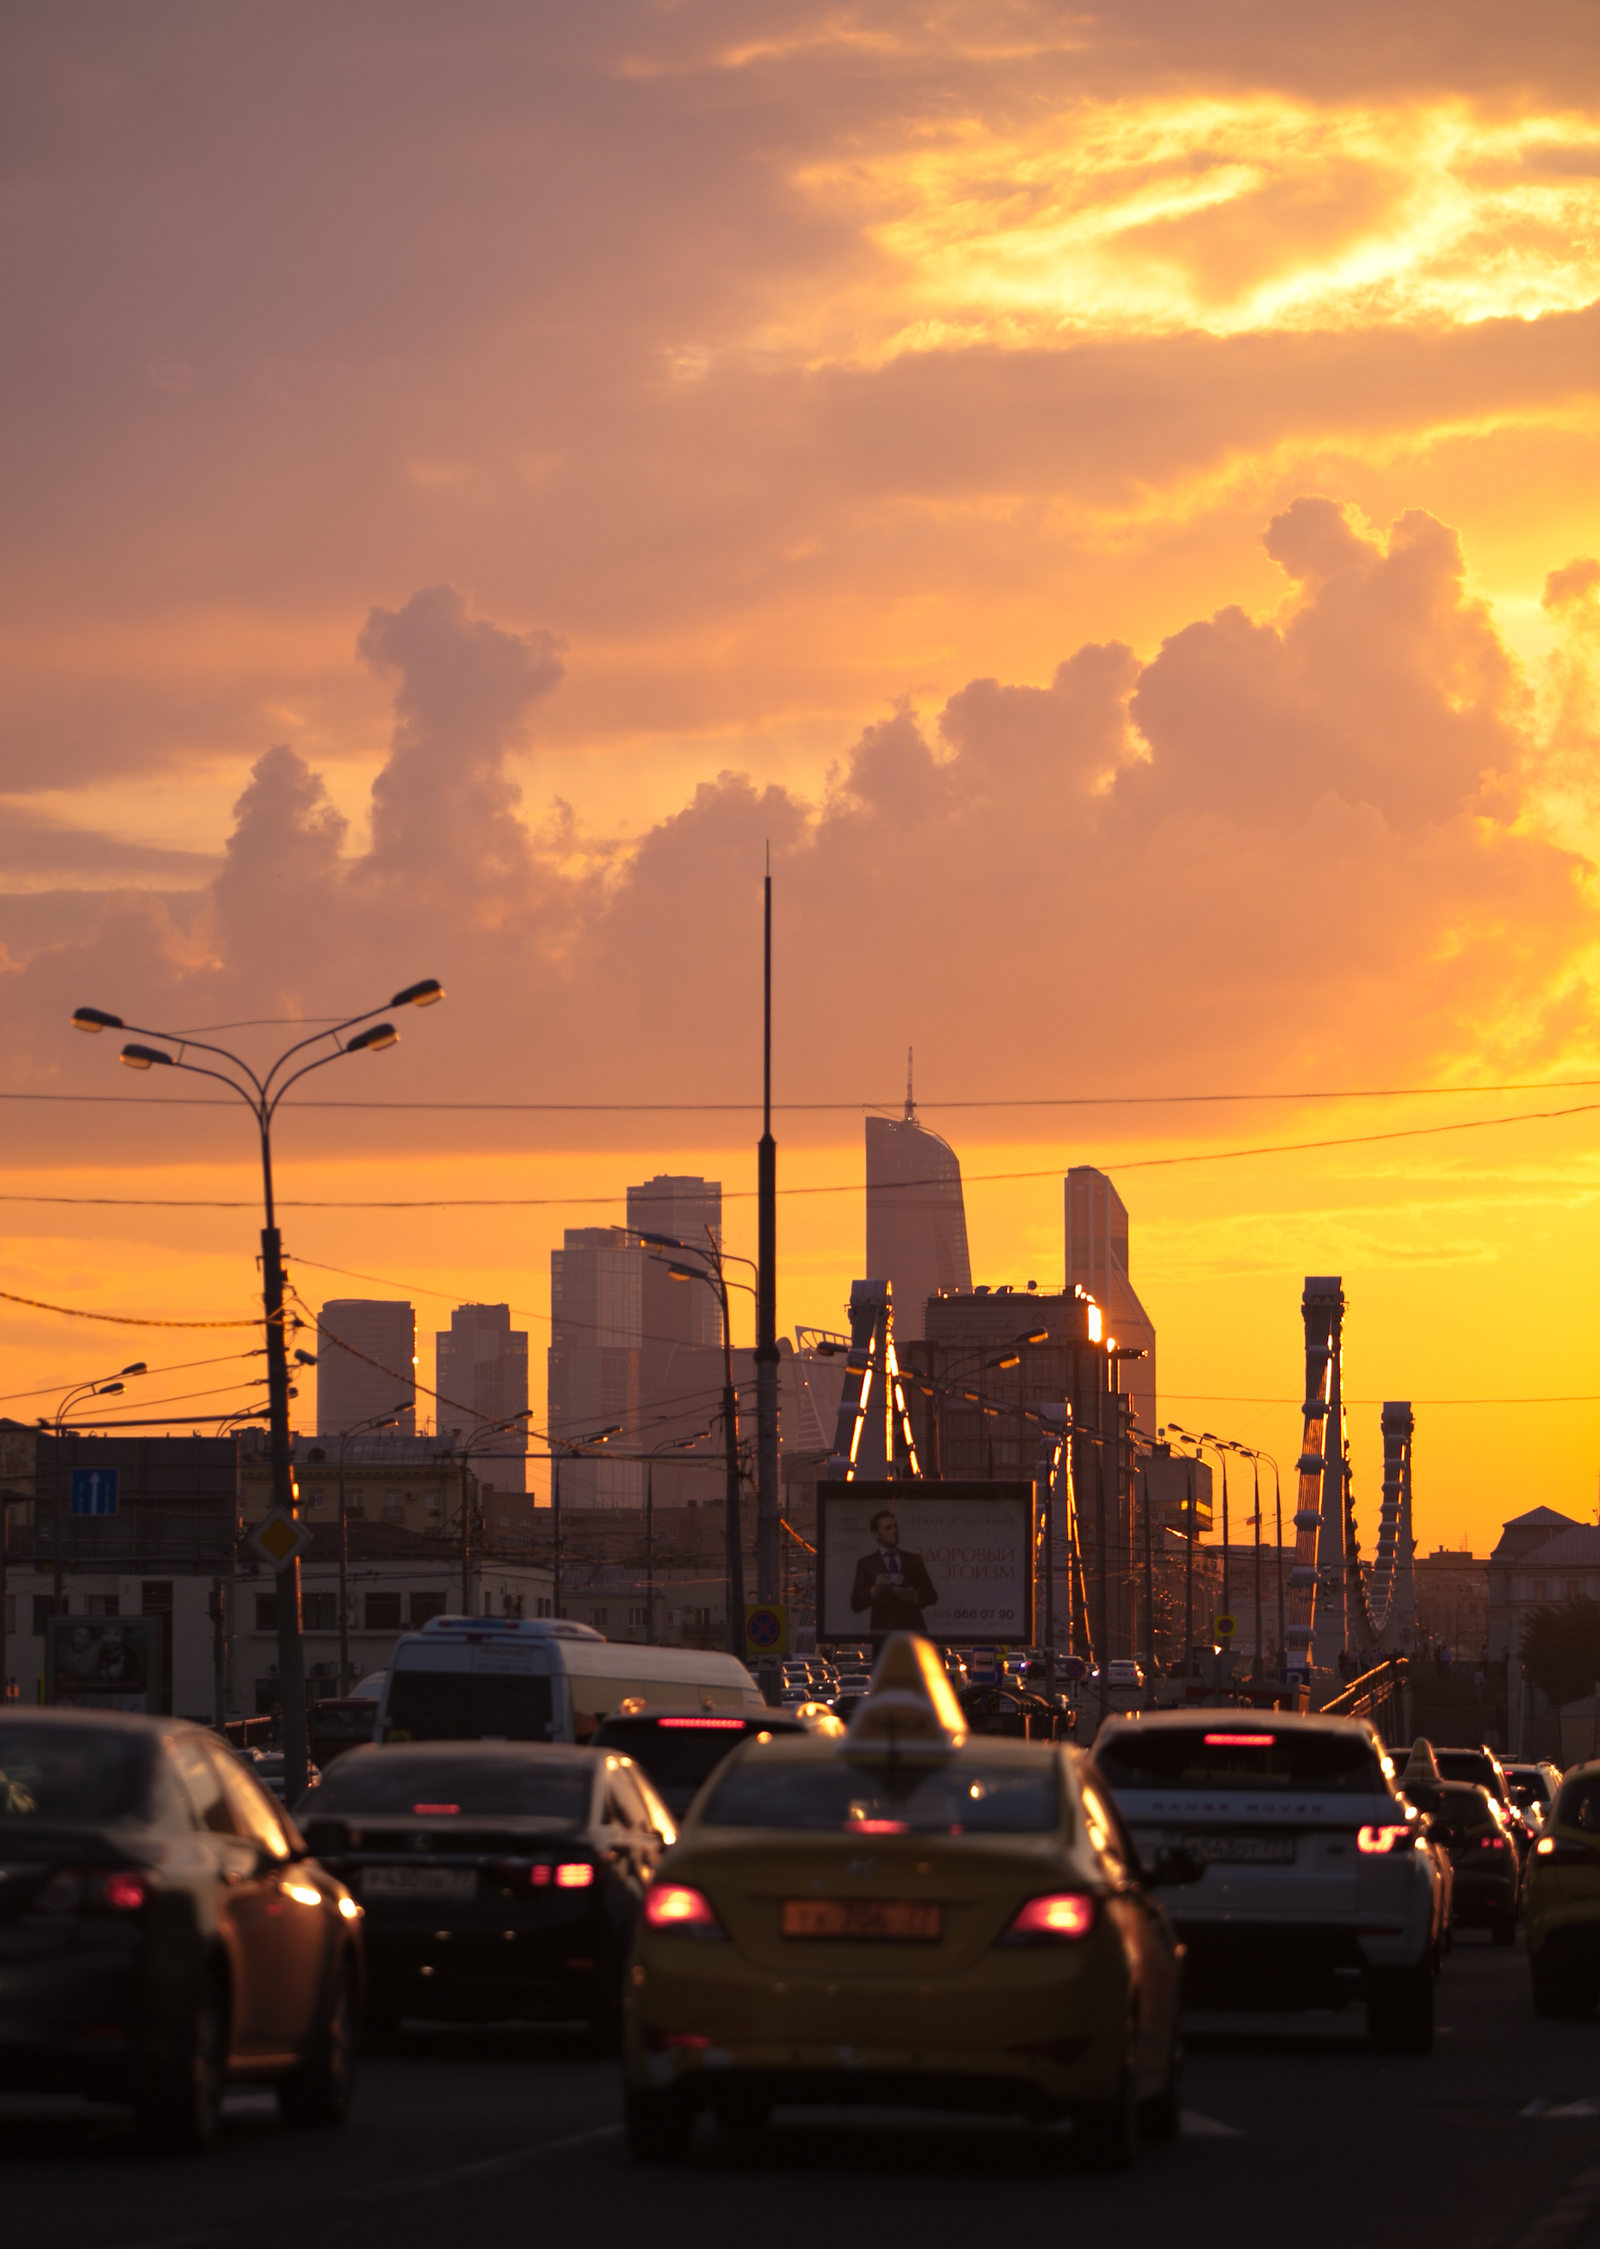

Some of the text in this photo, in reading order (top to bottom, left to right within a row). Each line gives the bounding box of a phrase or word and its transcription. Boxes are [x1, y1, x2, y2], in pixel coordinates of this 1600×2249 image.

[961, 1516, 1015, 1526] ДЫХАНИЕ
[913, 1544, 1015, 1562] ЗДОРОВЫЙ
[940, 1564, 1015, 1579] ЭГОИЗМ
[931, 1608, 1015, 1620] 495 668 07 90
[1286, 1671, 1304, 1684] P
[1151, 1802, 1323, 1813] RANGE ROVER
